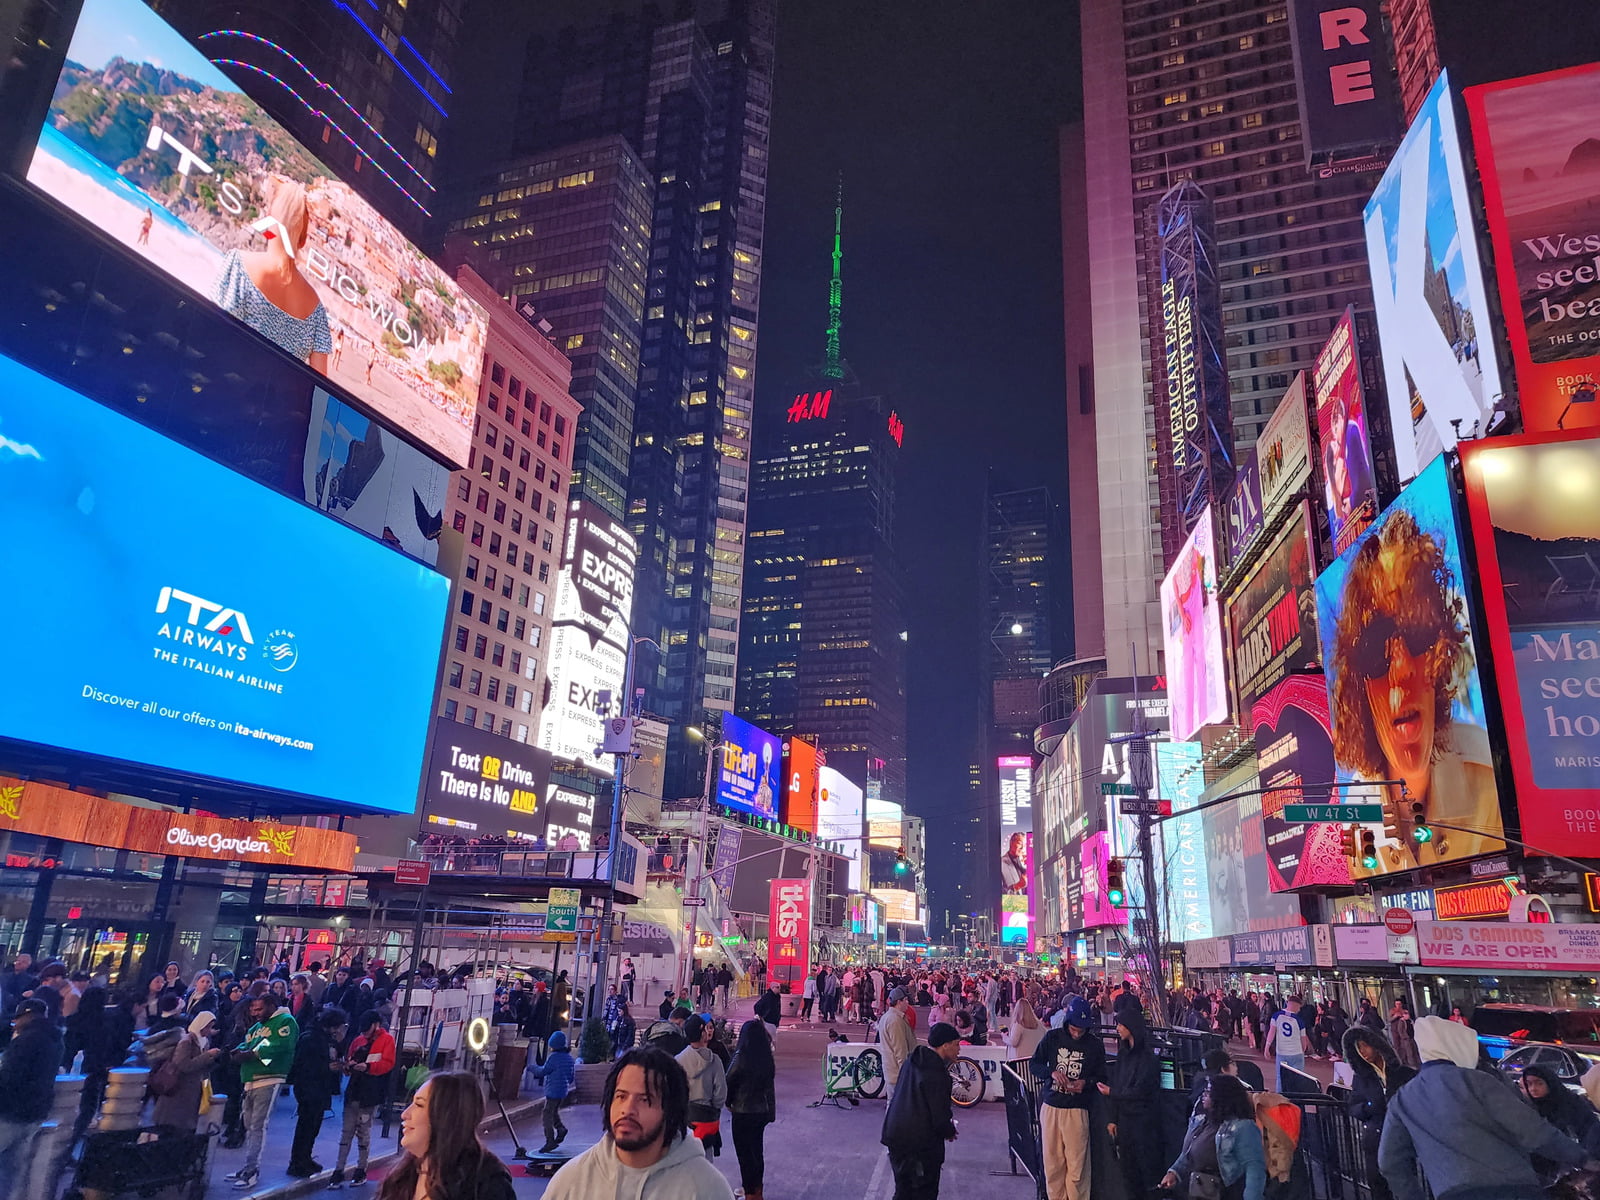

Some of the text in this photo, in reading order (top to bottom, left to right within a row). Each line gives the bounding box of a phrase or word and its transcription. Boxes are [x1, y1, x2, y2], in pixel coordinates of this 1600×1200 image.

[145, 125, 244, 216] IT'S
[305, 248, 360, 304] BIG
[368, 302, 436, 362] WOW
[1548, 333, 1575, 346] THE
[1161, 277, 1187, 468] AMERICAN EAGLE
[1177, 294, 1199, 433] OUTFITTERS
[1556, 372, 1594, 387] BOOK
[787, 389, 833, 424] H&M
[581, 548, 634, 598] EXPRE
[154, 585, 255, 645] ITA
[157, 621, 248, 661] AIRWAYS
[1530, 630, 1600, 663] Ma
[153, 647, 284, 695] THE ITALIAN AIRLINE
[575, 649, 603, 670] EXPRESS
[81, 683, 314, 751] Discover all our offers on ita-airways.com
[567, 709, 598, 729] EXPRESS
[451, 745, 535, 787] Text OR Drive.
[723, 740, 743, 774] LIFE
[440, 770, 539, 815] There Is No AND.
[555, 789, 587, 808] EXPRESS
[1103, 784, 1126, 794] W 47
[1306, 807, 1360, 820] W 47 St
[1567, 820, 1598, 833] THE
[166, 827, 270, 854] Olive Garden
[747, 812, 846, 854] 1540 BRODWAY
[1183, 822, 1200, 932] AMERICAN
[549, 907, 576, 916] South
[778, 883, 805, 939] tkts
[1410, 889, 1431, 911] FIN
[1436, 883, 1509, 917] DOS CAMINOS
[1259, 931, 1280, 953] NOW
[1281, 929, 1307, 951] OPEN
[1423, 943, 1558, 959] WE ARE OPEN
[1431, 926, 1545, 943] DOS CAMINOS
[1281, 1021, 1293, 1038] 9
